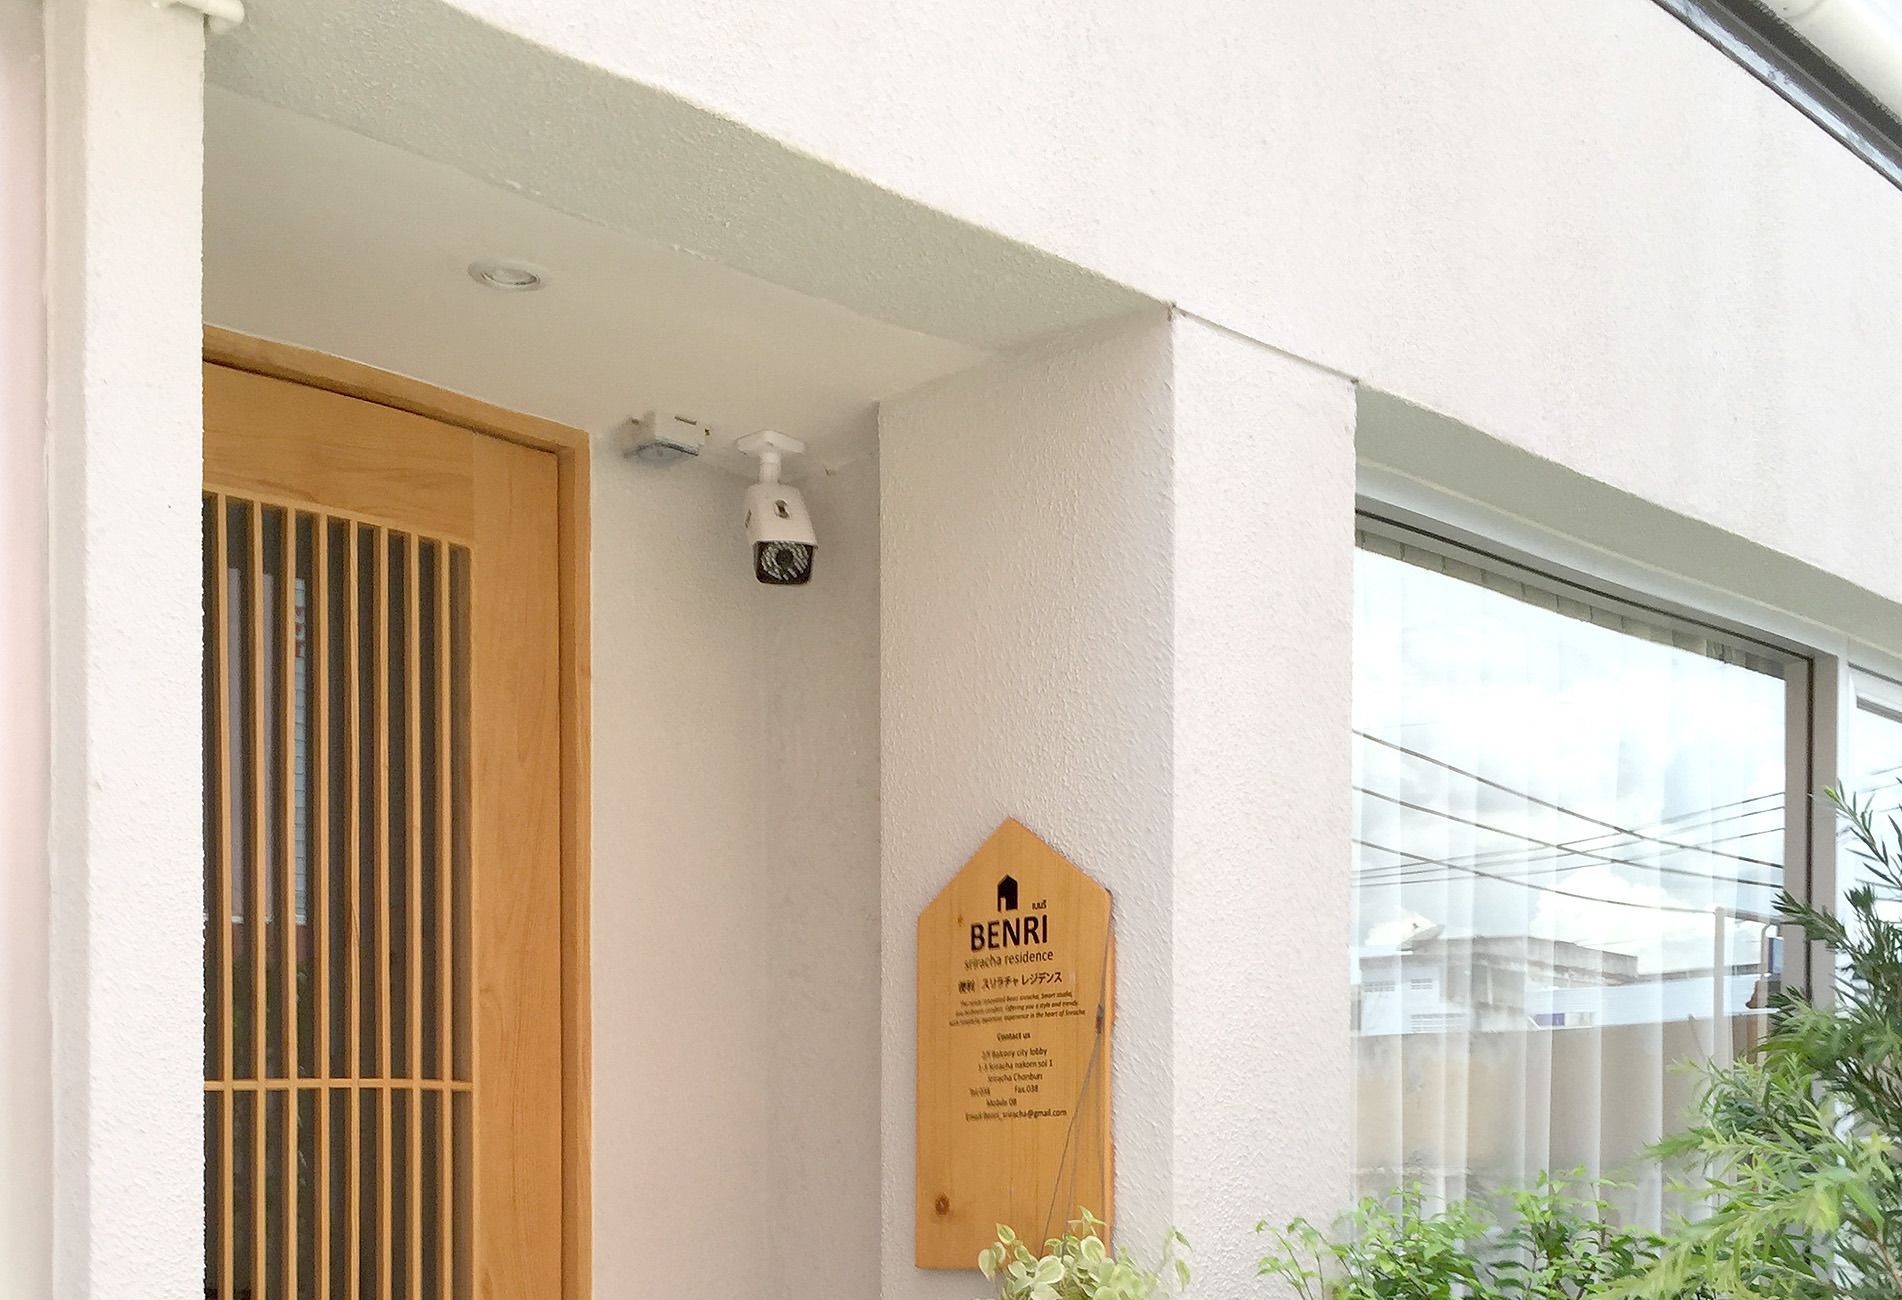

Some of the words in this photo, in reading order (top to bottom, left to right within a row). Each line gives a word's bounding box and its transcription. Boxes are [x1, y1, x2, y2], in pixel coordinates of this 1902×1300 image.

[970, 914, 1048, 952] BENRI
[1004, 951, 1054, 965] residence
[997, 1032, 1022, 1042] Contact
[1029, 1047, 1047, 1057] lobby
